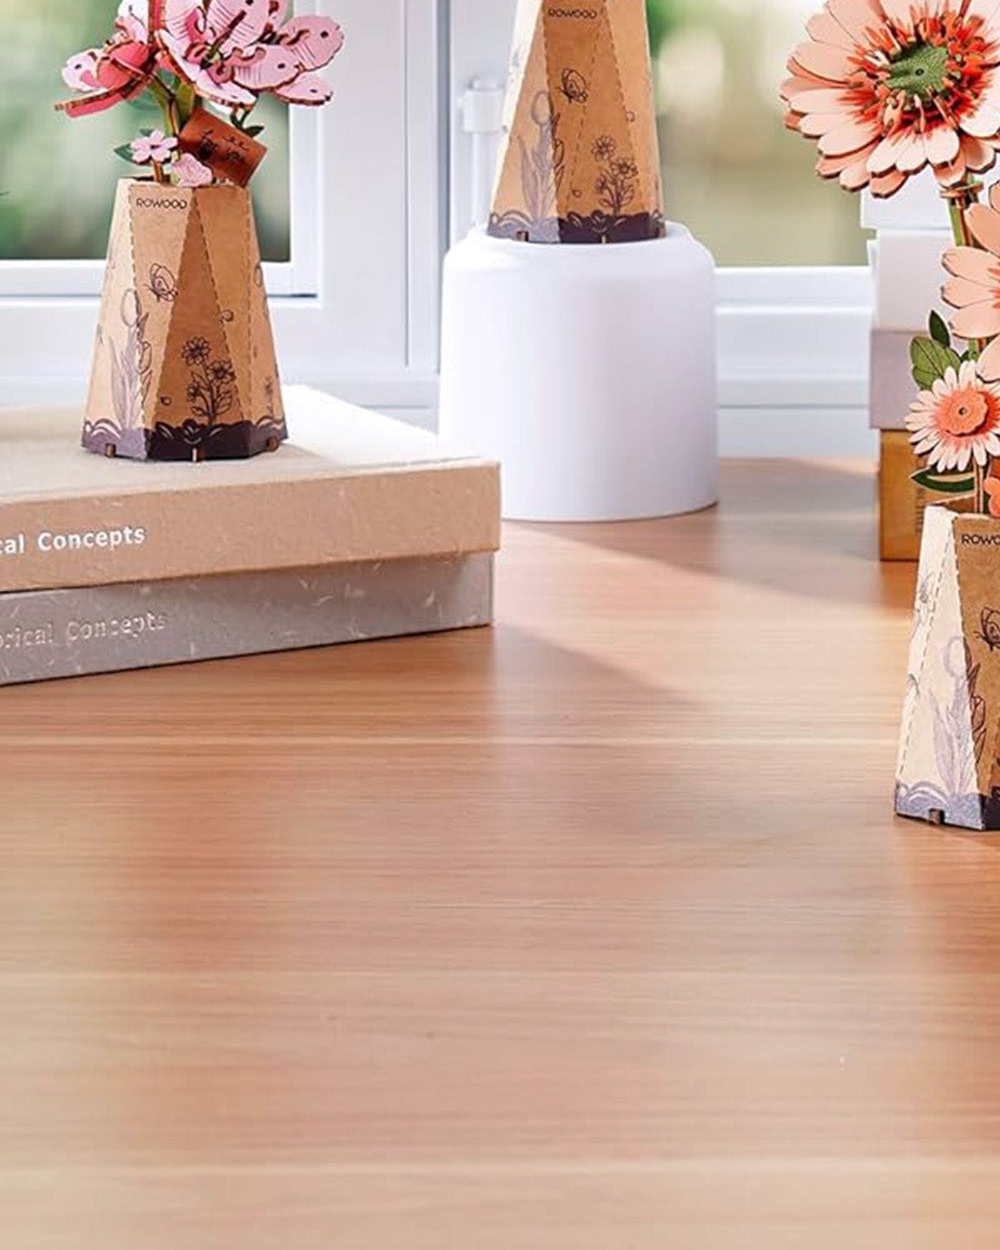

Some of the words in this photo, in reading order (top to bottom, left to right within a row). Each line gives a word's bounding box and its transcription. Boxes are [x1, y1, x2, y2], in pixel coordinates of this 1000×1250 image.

[136, 198, 188, 210] ROWOOD
[37, 526, 146, 551] Concepts
[66, 612, 168, 643] Concepts
